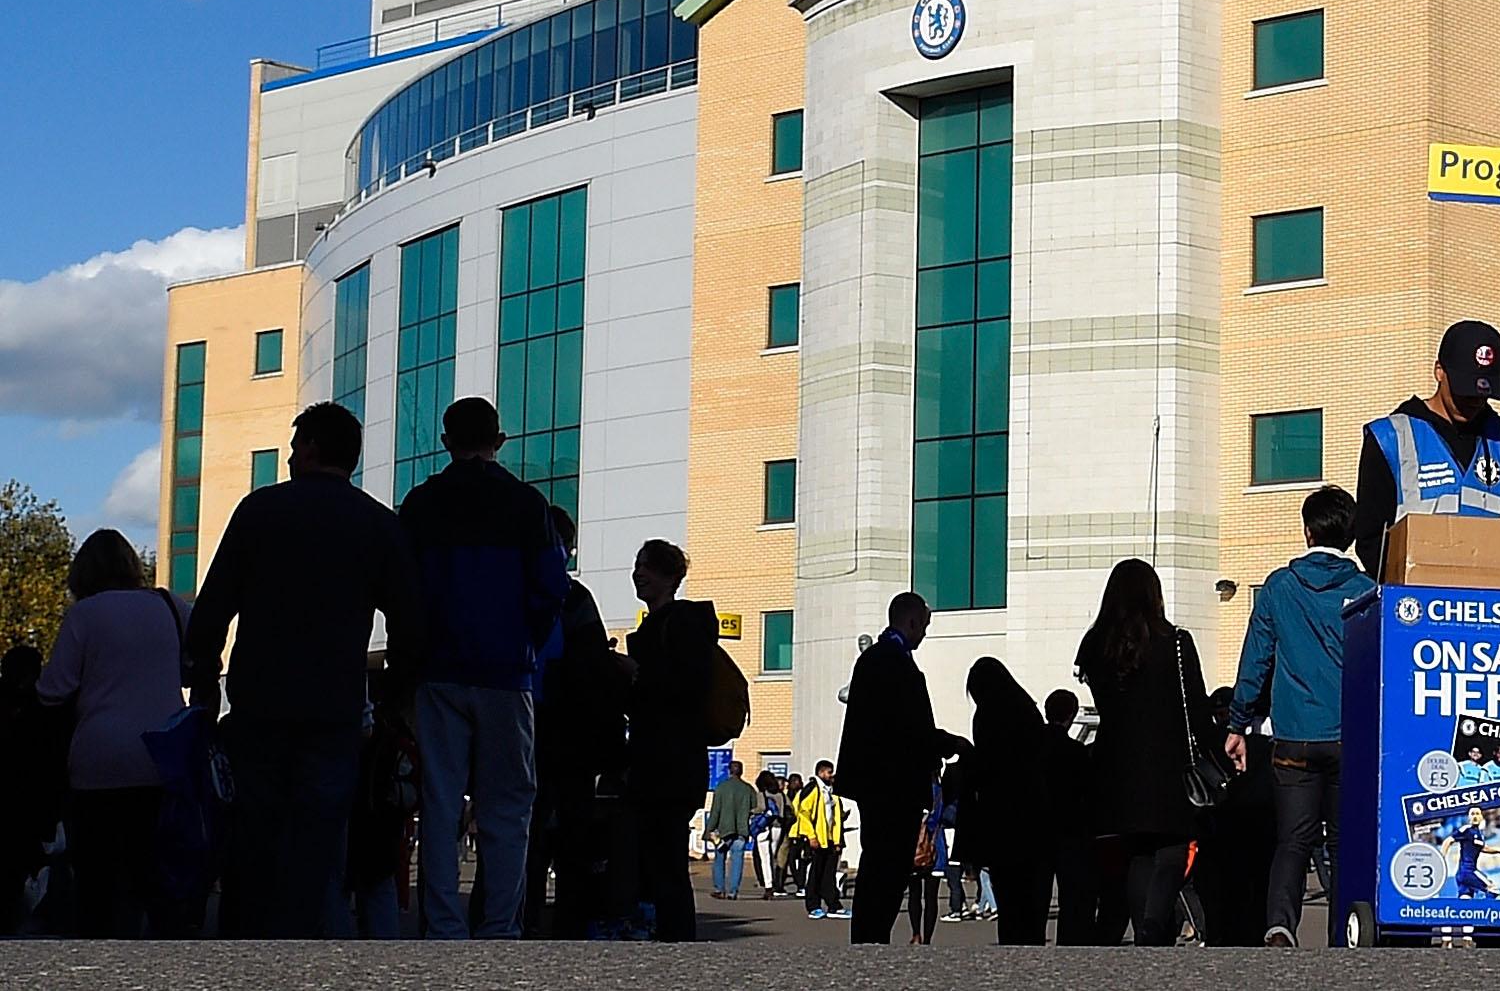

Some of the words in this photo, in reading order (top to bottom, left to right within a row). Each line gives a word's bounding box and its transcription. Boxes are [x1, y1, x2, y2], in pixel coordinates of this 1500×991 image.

[1413, 639, 1466, 670] ON
[1429, 771, 1449, 787] £5
[1427, 791, 1489, 811] CHELSEA
[1403, 865, 1434, 888] £3
